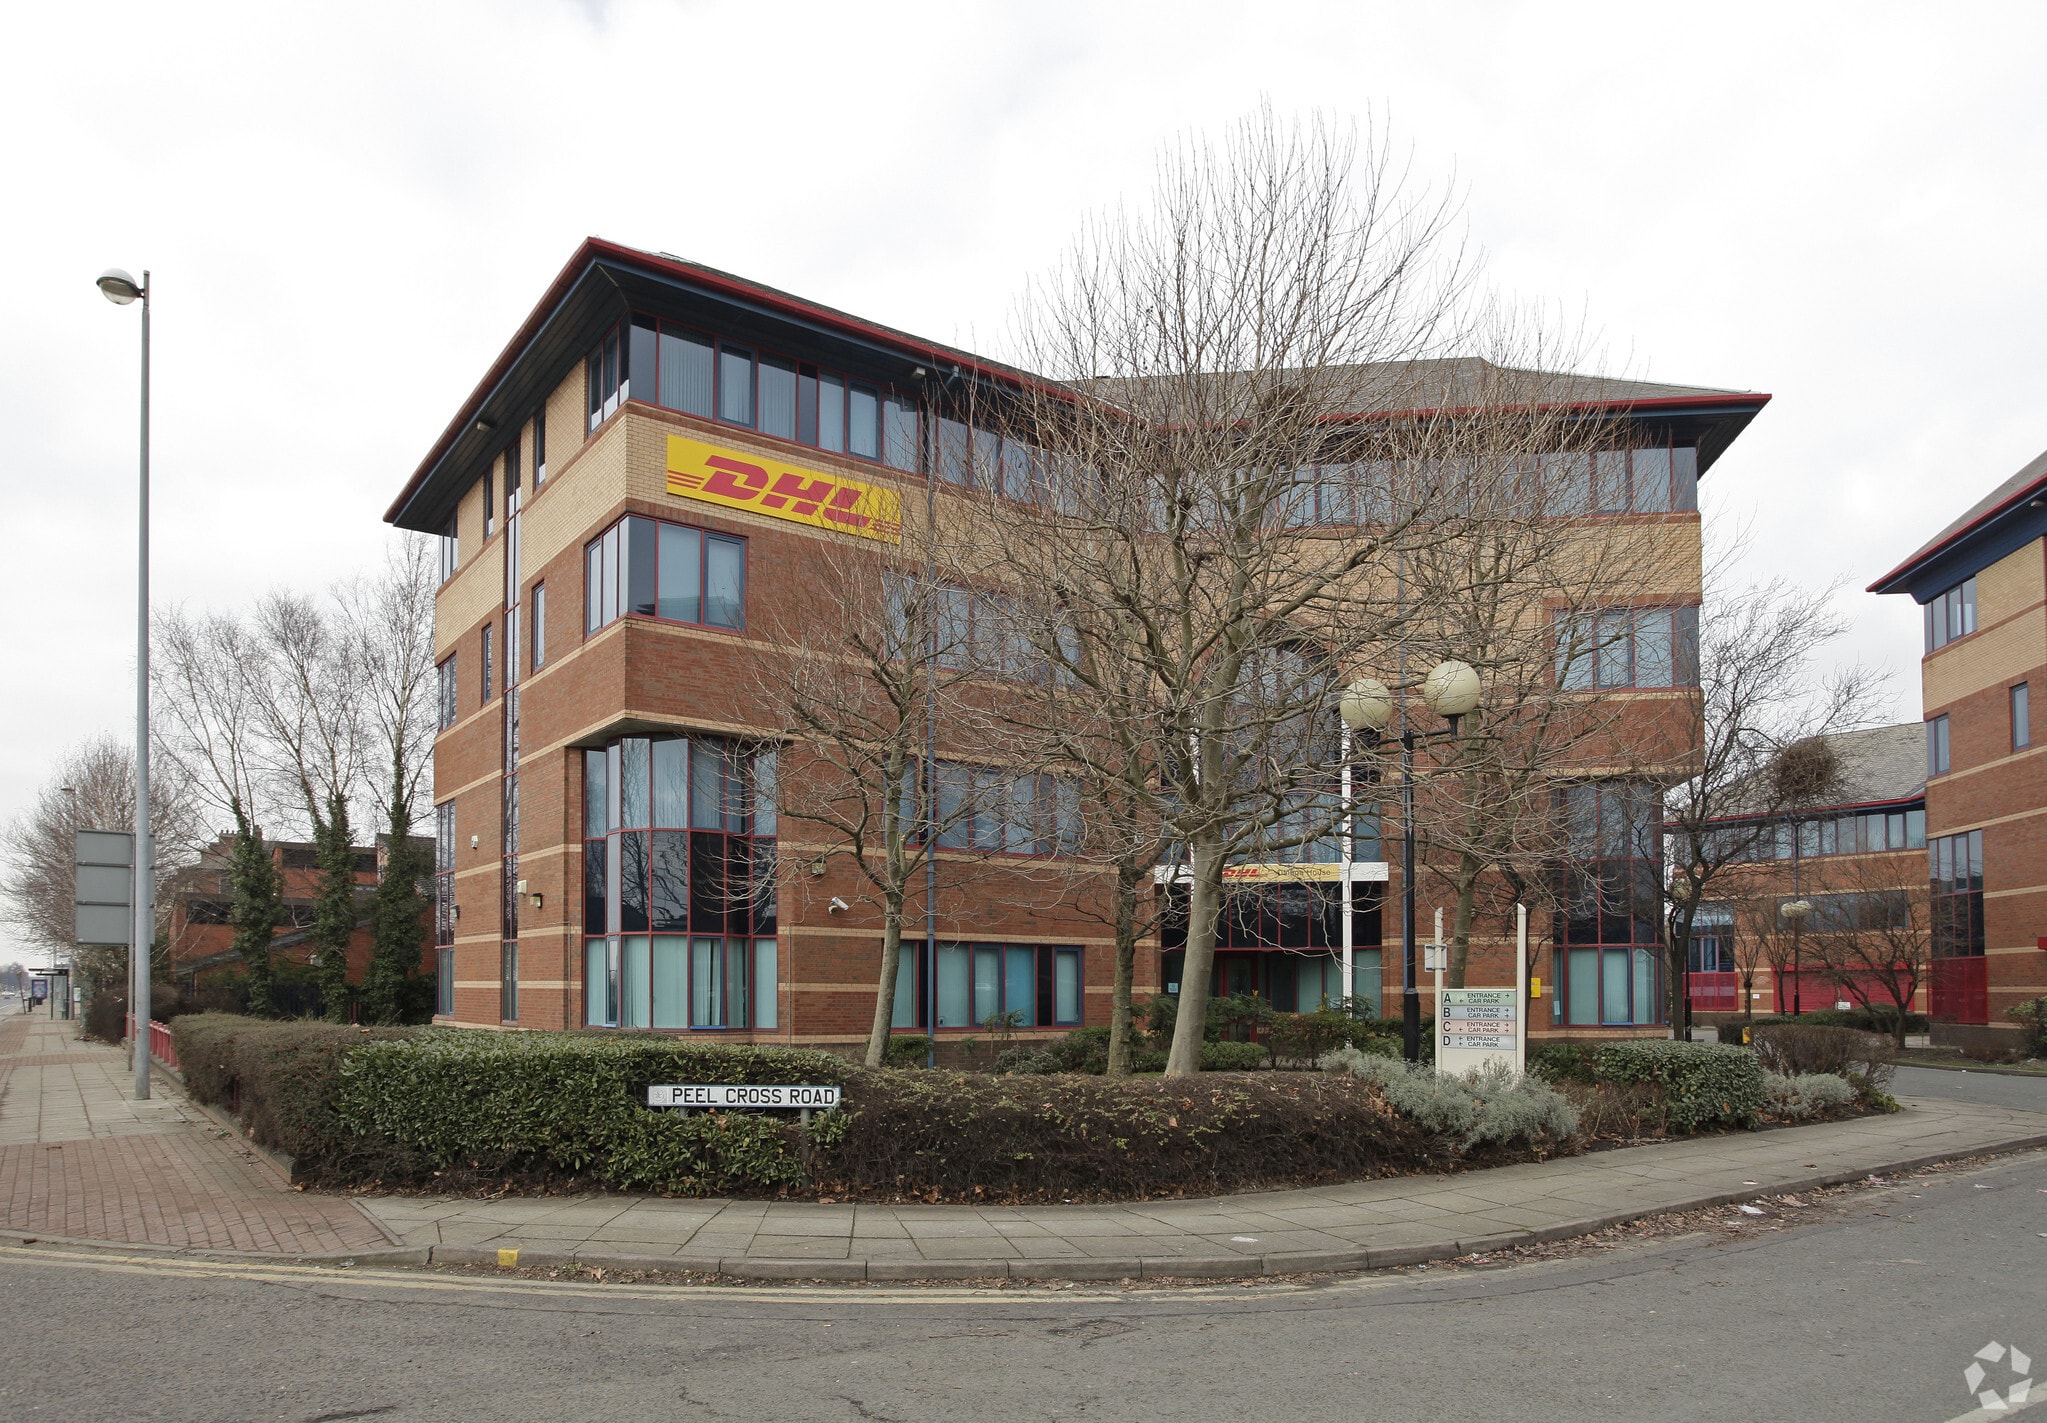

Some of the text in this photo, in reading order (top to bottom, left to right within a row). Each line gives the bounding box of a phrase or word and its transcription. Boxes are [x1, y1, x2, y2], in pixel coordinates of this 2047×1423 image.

[701, 454, 872, 528] DHL
[1443, 993, 1451, 1003] A
[1443, 1008, 1451, 1018] B
[1443, 1021, 1451, 1032] C
[1443, 1036, 1451, 1046] D
[672, 1087, 835, 1105] PEEL CROSS ROAD
